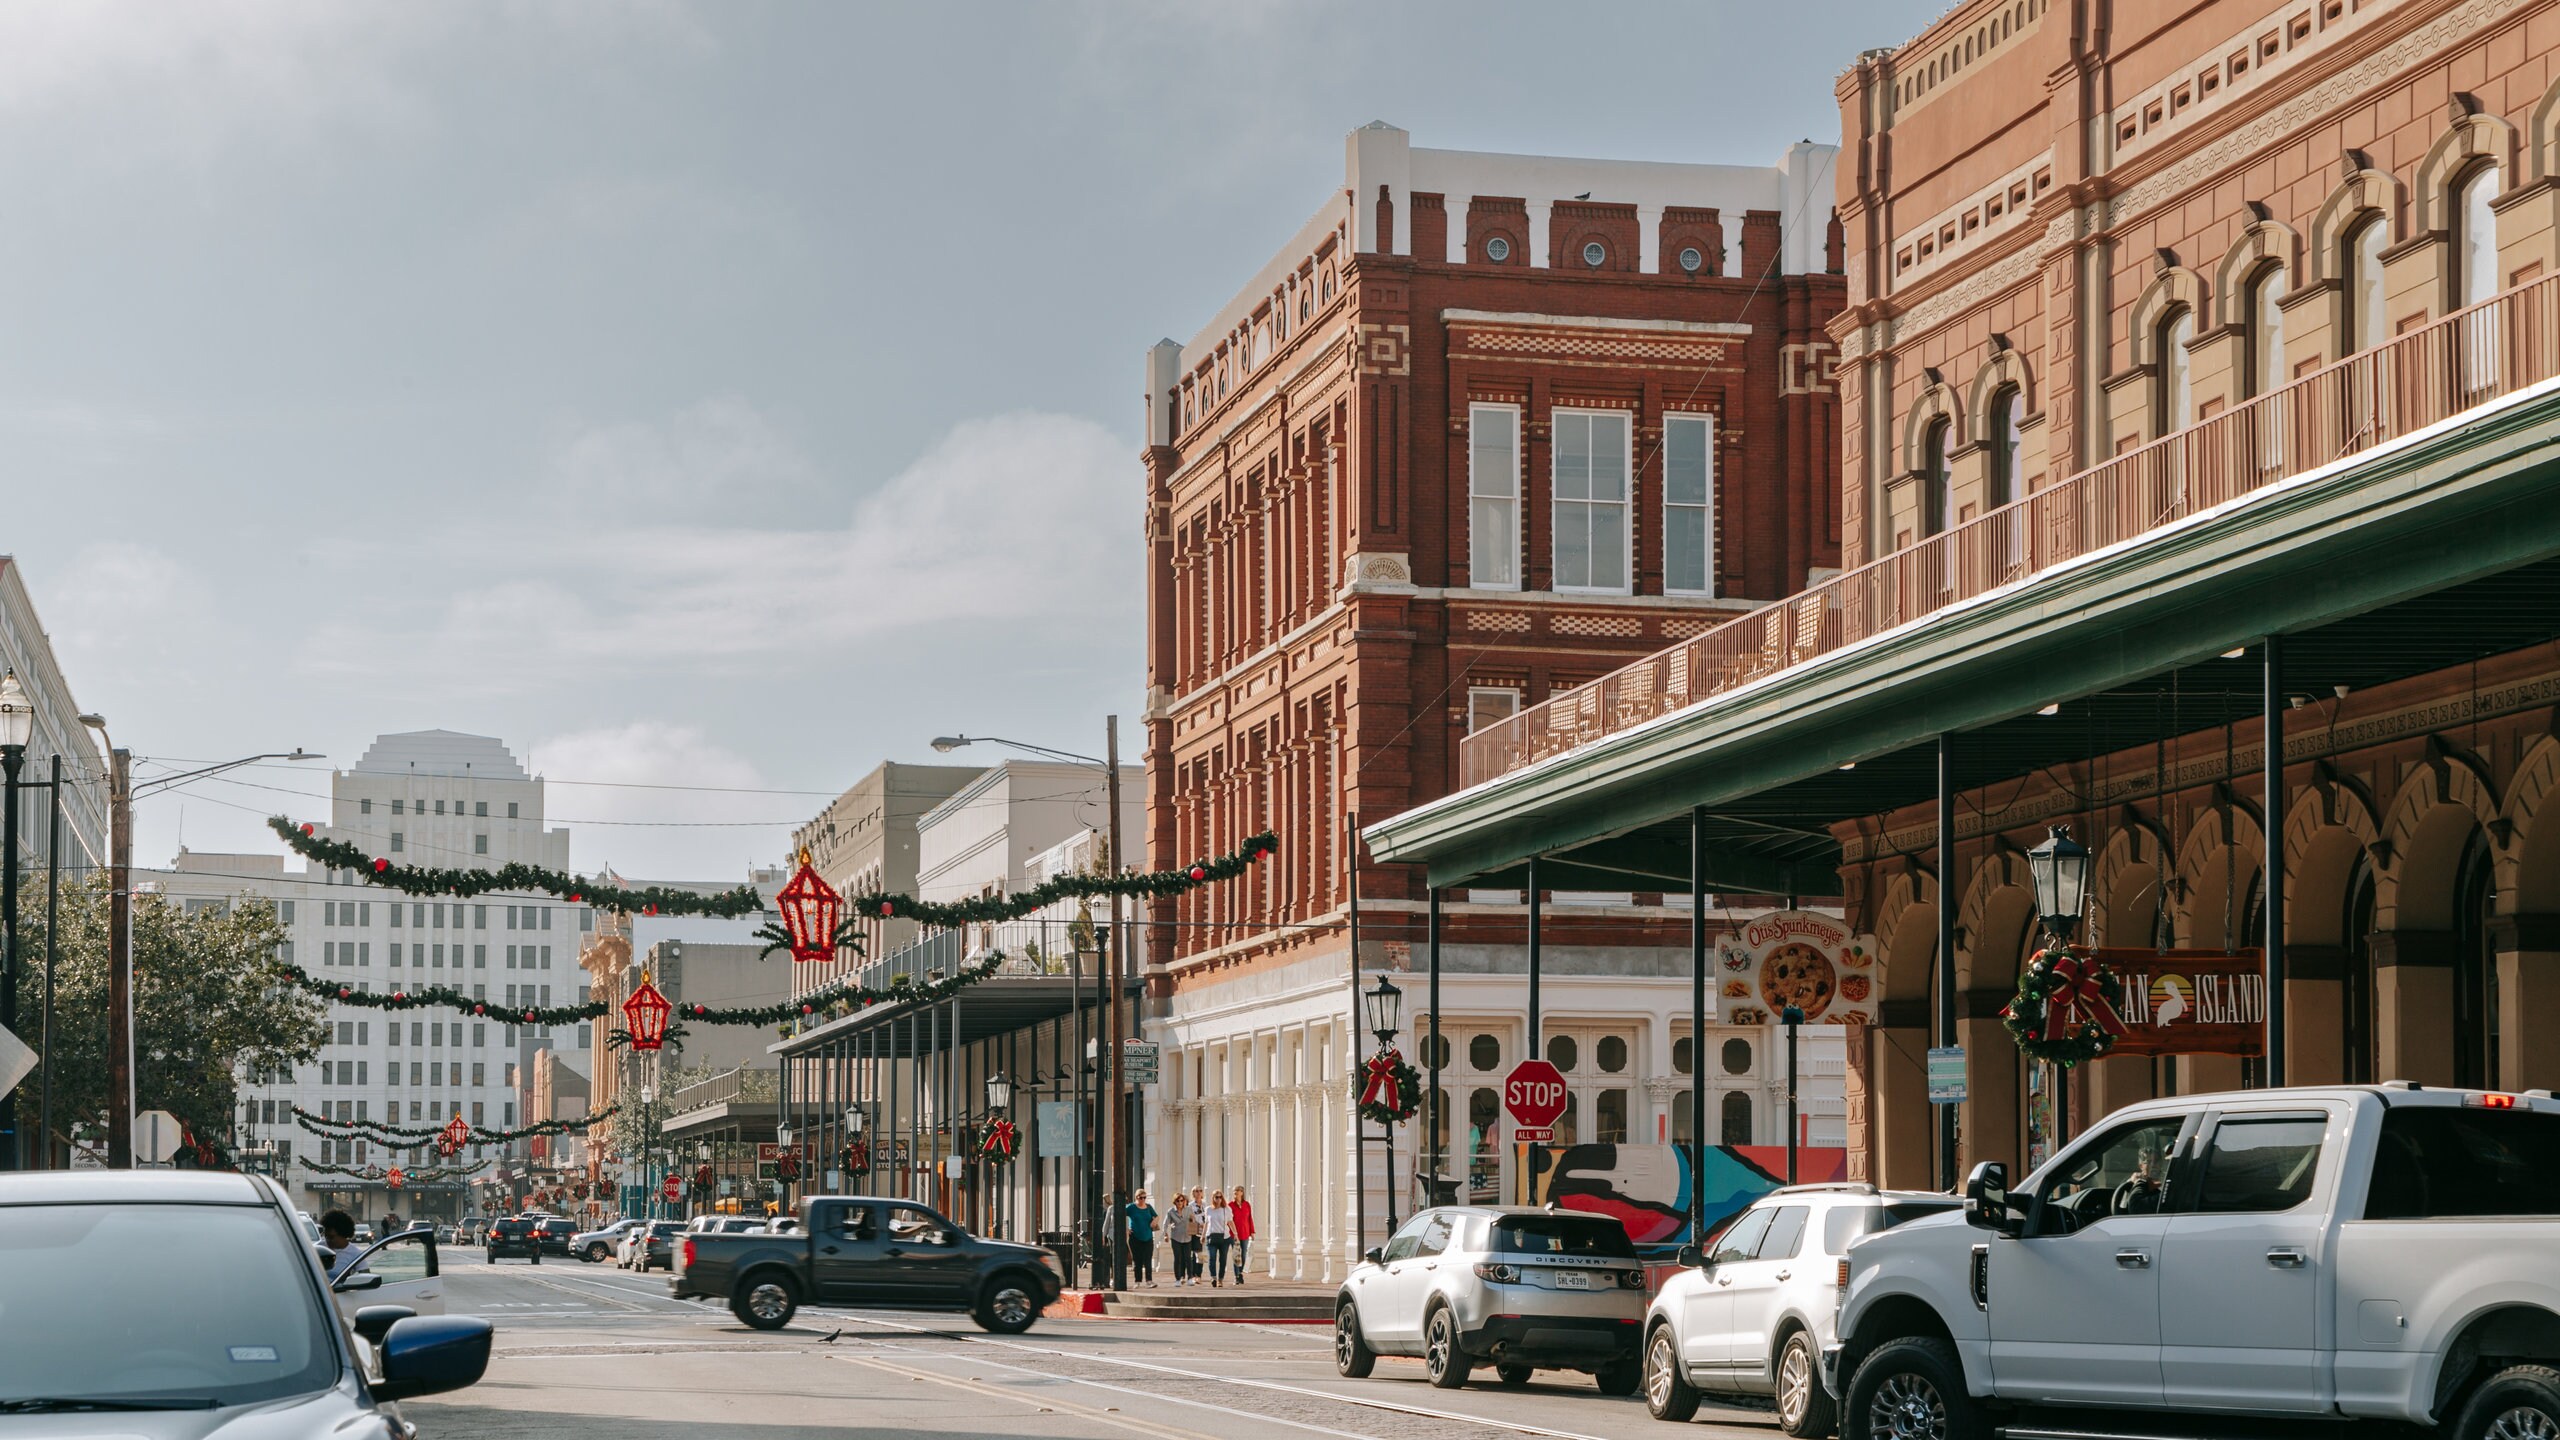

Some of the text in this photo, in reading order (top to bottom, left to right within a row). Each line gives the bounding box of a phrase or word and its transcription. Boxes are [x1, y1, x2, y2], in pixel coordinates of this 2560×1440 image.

[1748, 915, 1844, 947] Otis Spunkmeyer
[2195, 974, 2264, 1024] ISLAND
[1508, 1080, 1563, 1107] STOP
[1518, 1131, 1551, 1140] ALL WAY
[664, 1184, 679, 1192] STO
